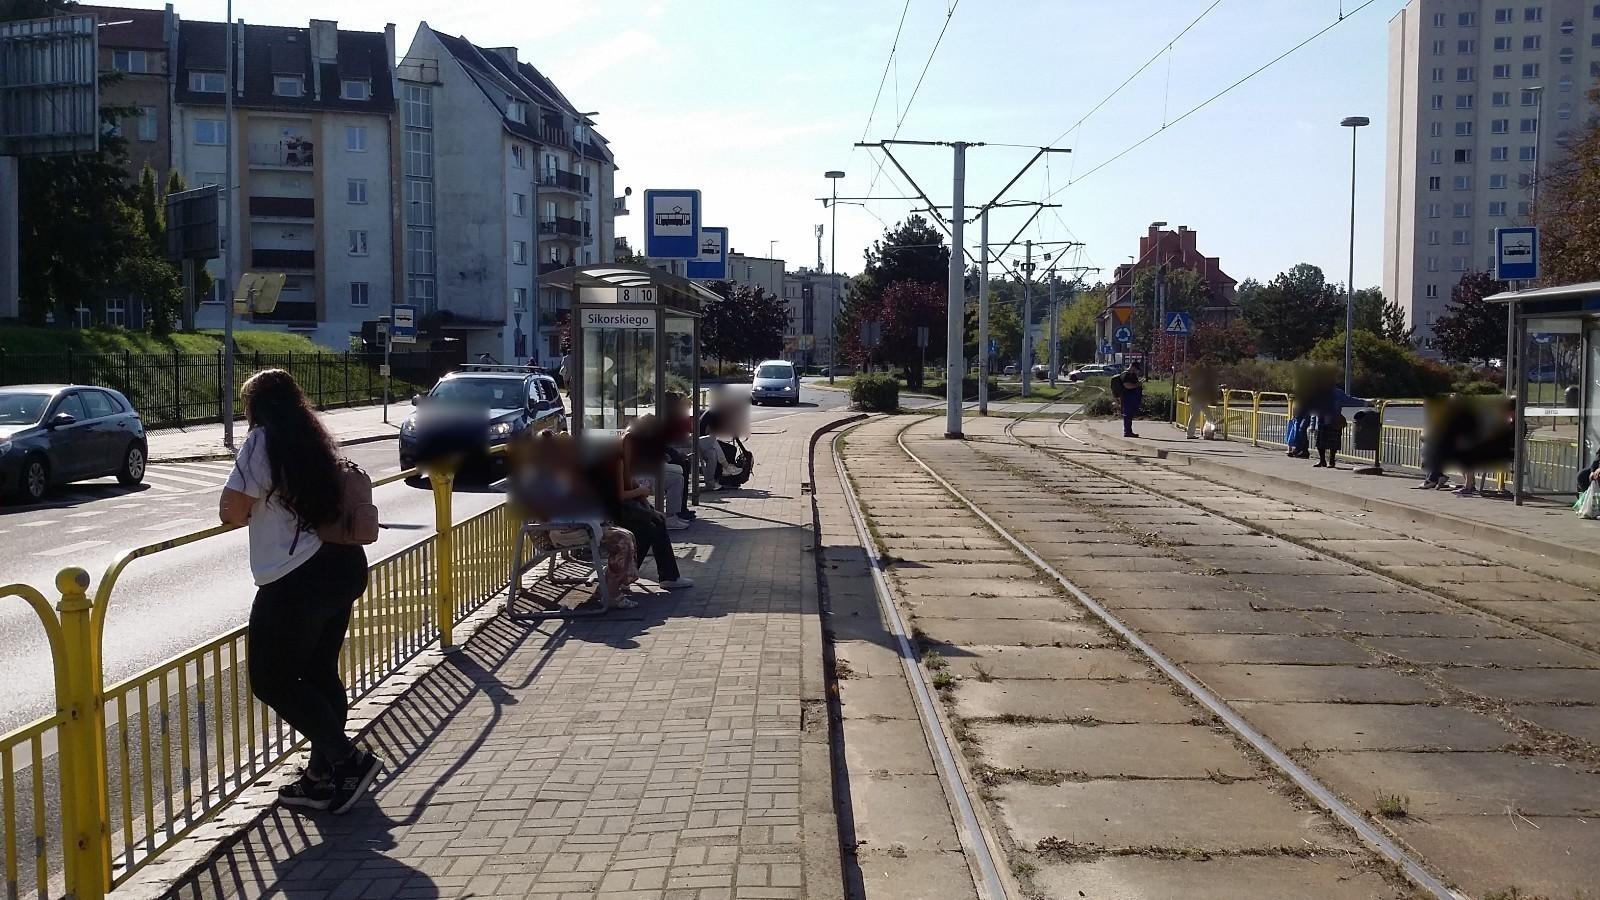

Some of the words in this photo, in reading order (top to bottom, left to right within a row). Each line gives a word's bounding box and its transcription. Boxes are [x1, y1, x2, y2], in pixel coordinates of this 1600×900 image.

[623, 289, 630, 301] 8
[641, 289, 653, 301] 10
[588, 313, 649, 327] Sikorskiego
